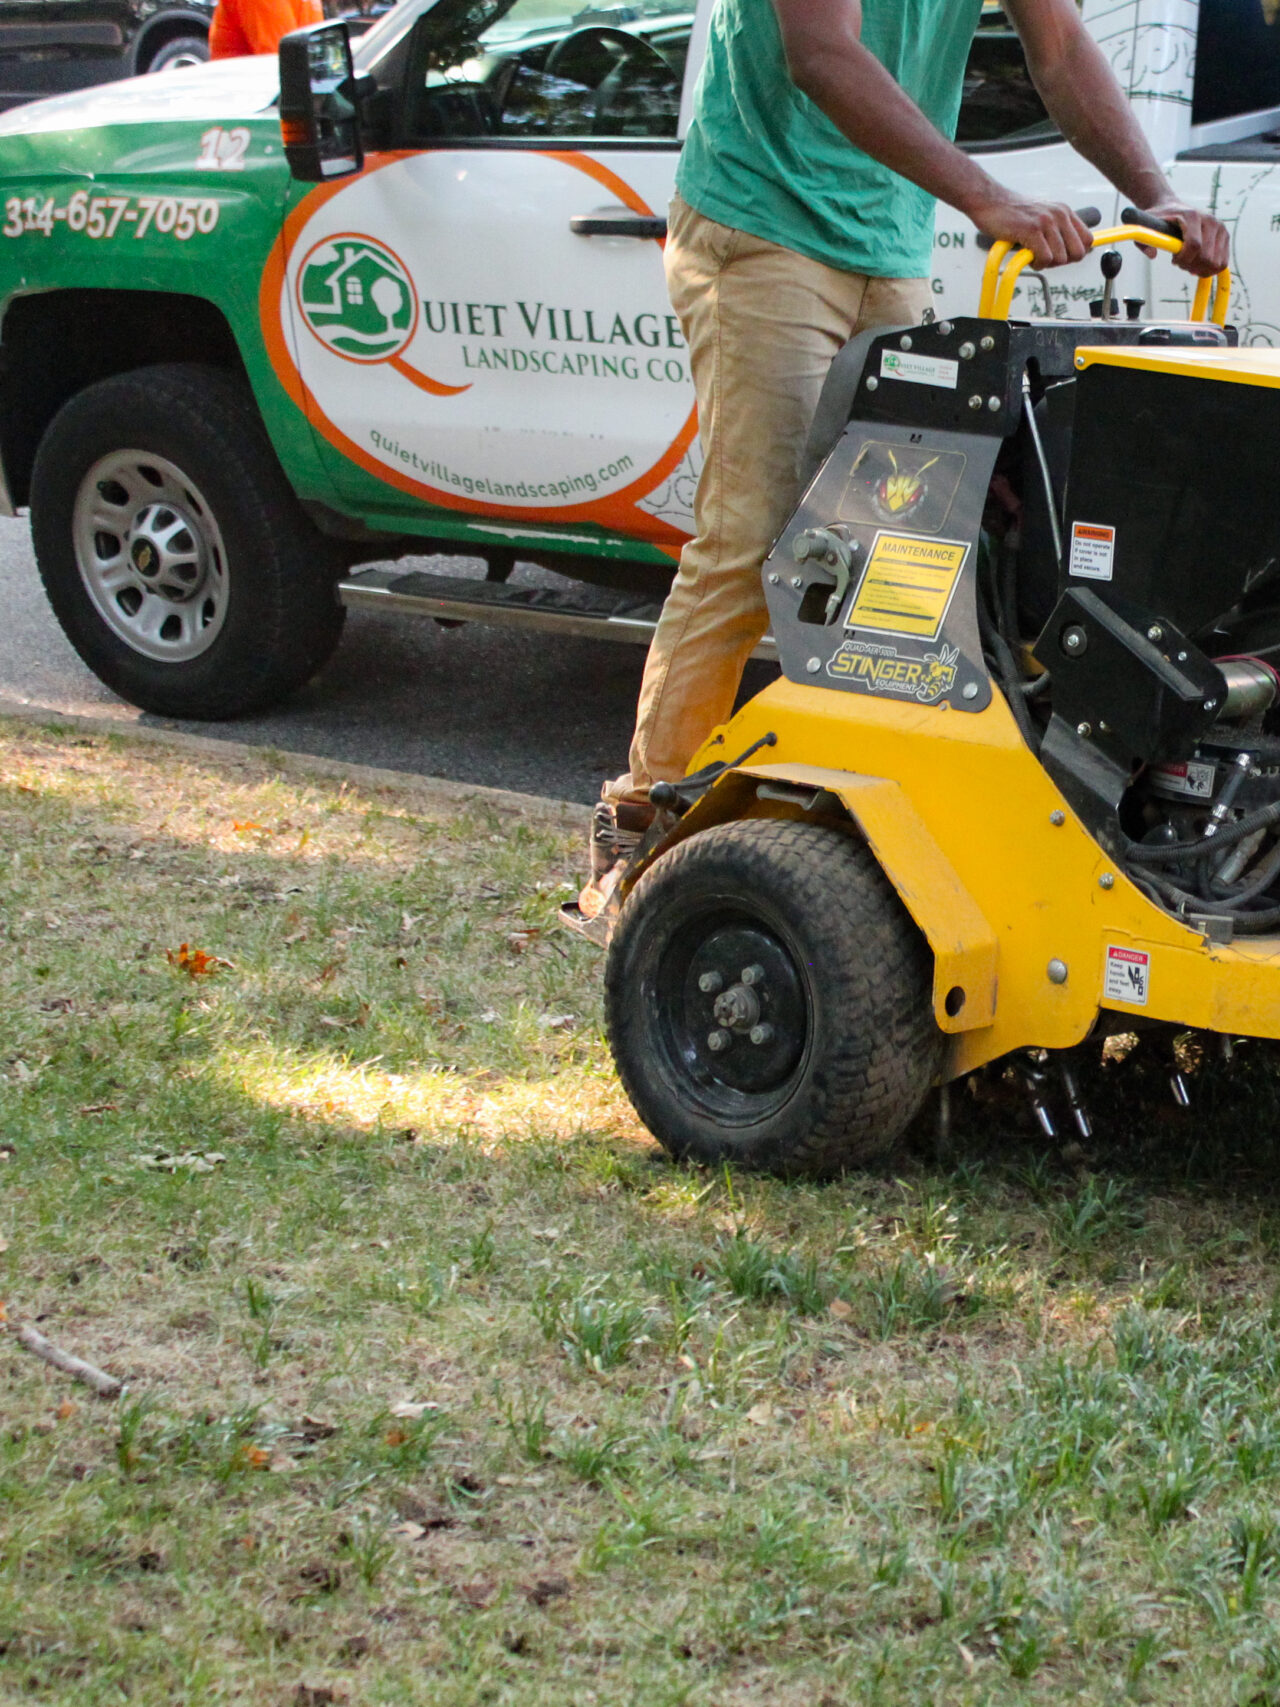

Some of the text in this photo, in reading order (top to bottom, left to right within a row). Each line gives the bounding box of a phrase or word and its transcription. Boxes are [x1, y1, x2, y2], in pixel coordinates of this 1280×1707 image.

[195, 126, 251, 171] 12
[3, 190, 220, 240] 314-657-7050
[516, 301, 685, 349] VILLAGE
[461, 345, 692, 384] LANDSCAPING CO.
[369, 428, 634, 500] quietvillagelandscaping.com
[881, 542, 956, 561] MAINTENANCE
[832, 653, 922, 683] STINGER
[875, 679, 917, 691] EQUIPMENT
[1118, 951, 1144, 962] DANGER
